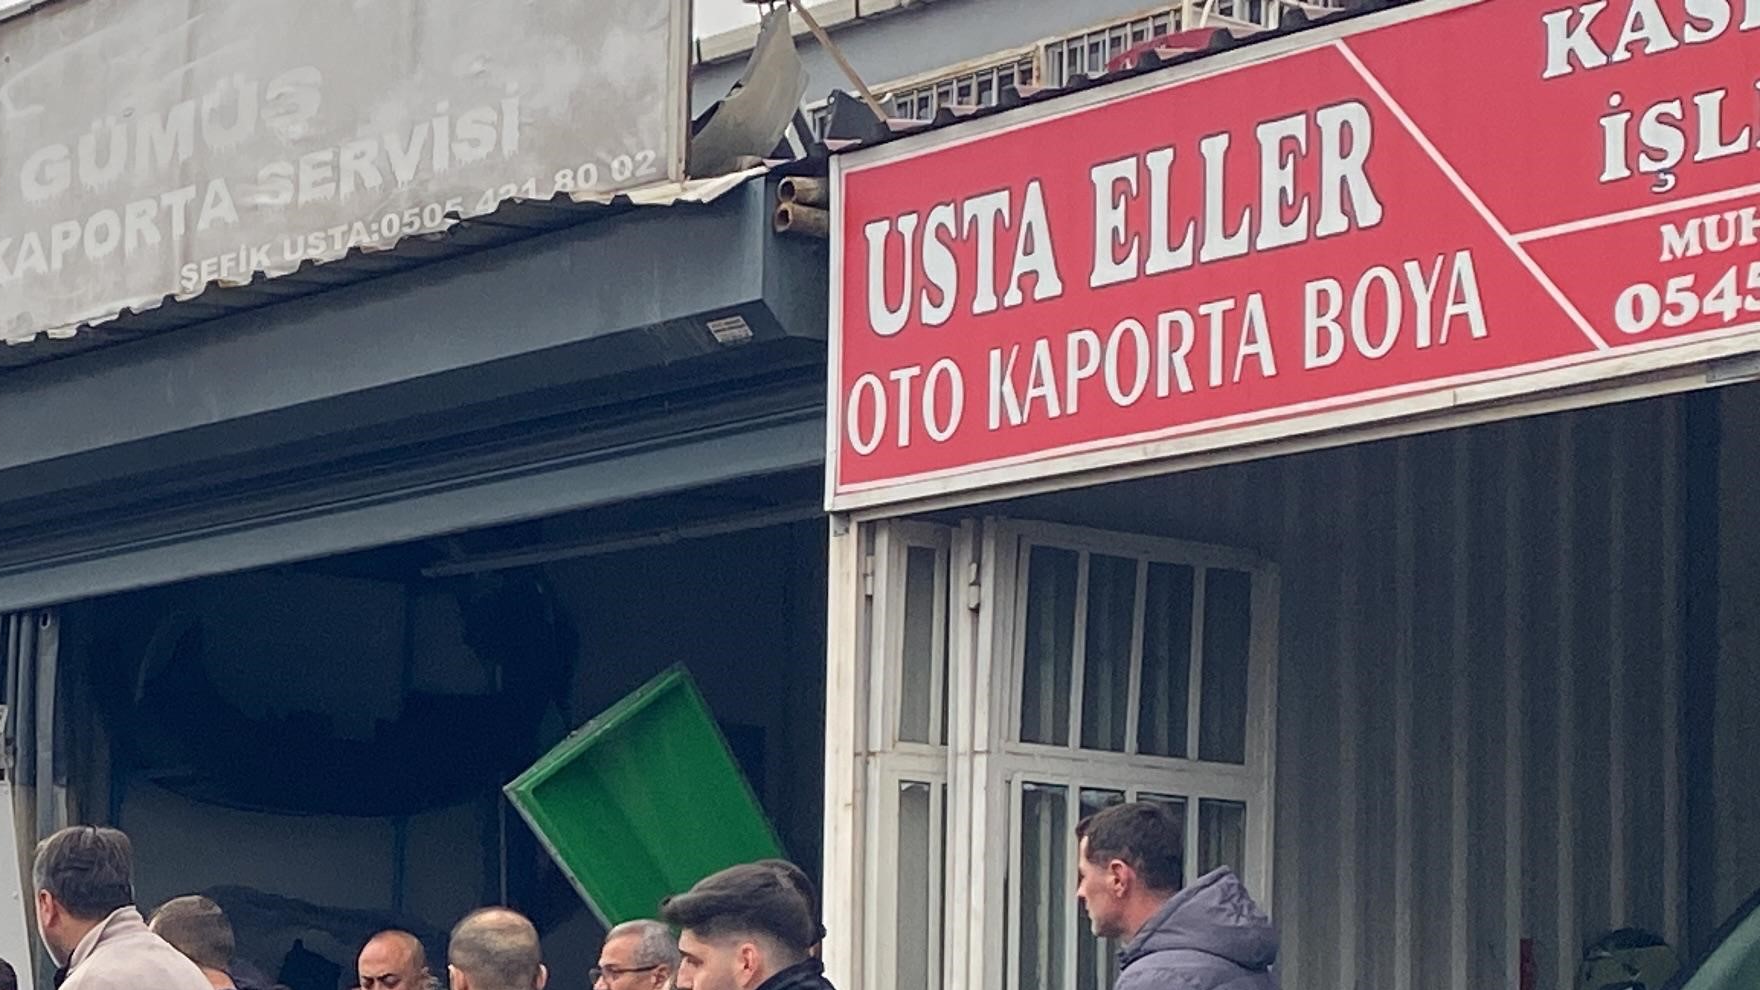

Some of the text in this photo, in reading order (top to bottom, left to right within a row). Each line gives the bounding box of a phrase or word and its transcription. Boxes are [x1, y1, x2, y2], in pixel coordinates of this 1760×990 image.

[553, 162, 599, 193] 80
[610, 148, 658, 183] 02
[1599, 79, 1760, 193] İŞL
[864, 98, 1384, 337] USTA ELLER
[846, 249, 1488, 456] OTO KAPORTA BOYA
